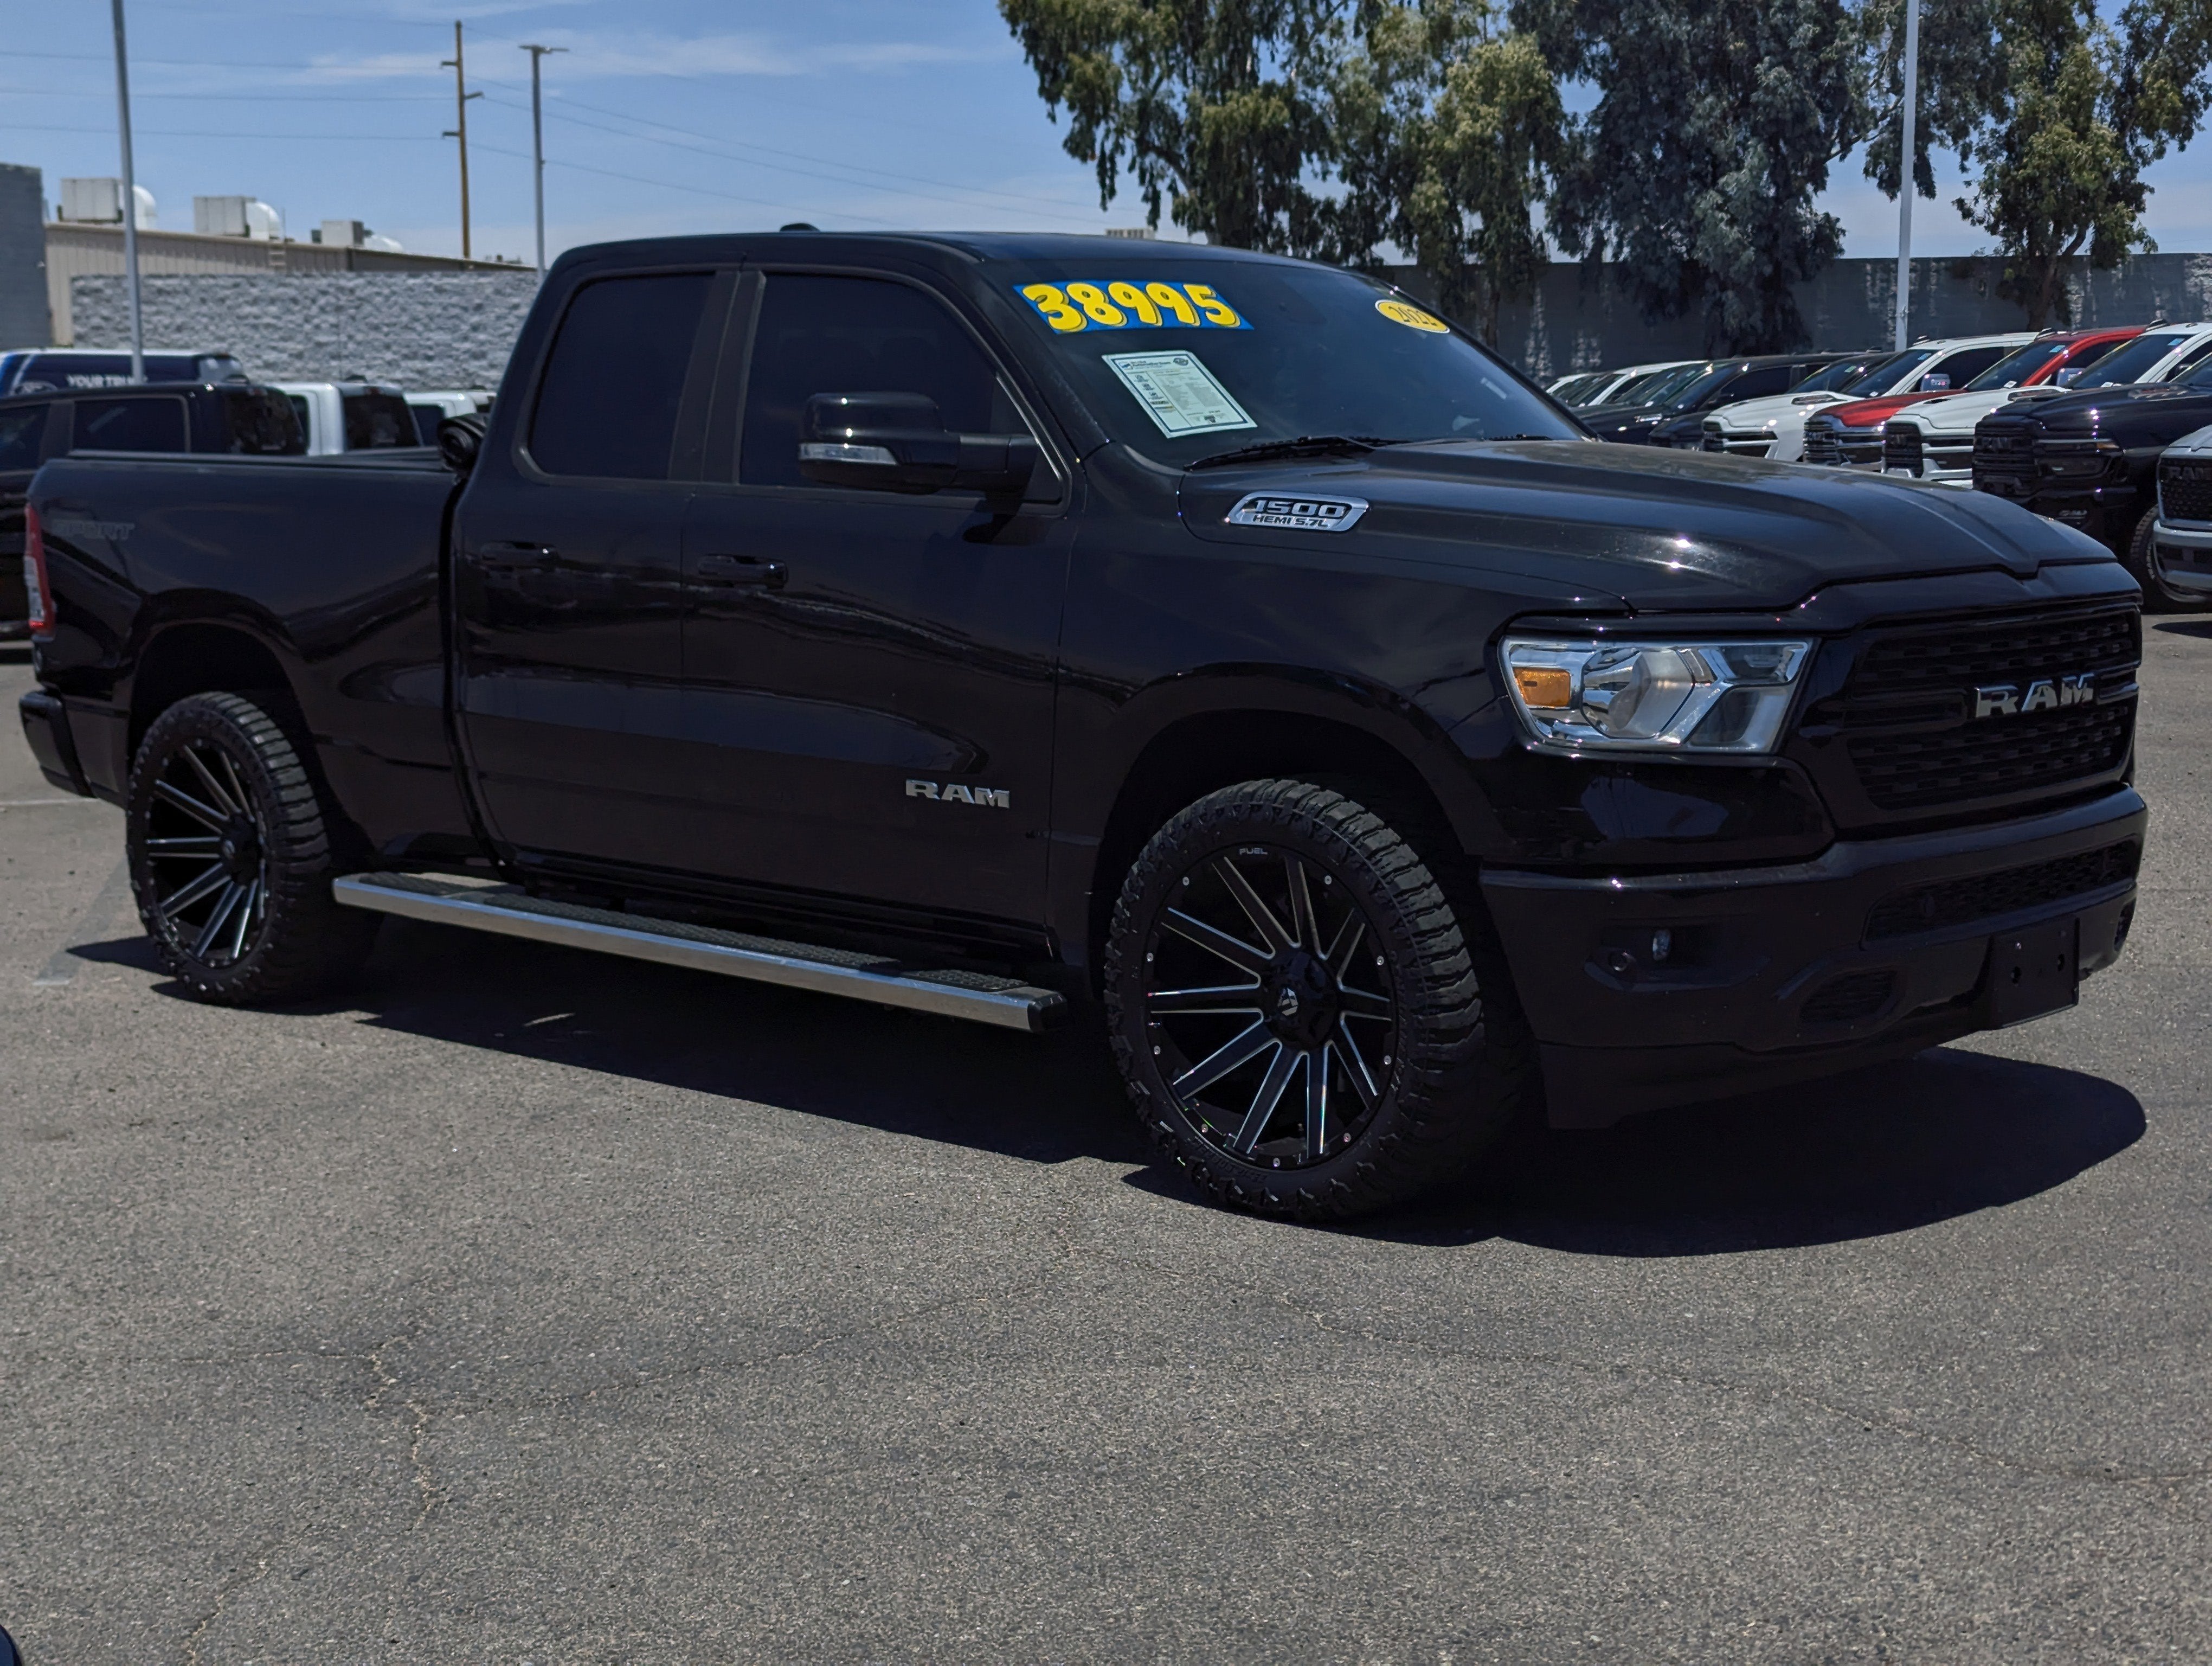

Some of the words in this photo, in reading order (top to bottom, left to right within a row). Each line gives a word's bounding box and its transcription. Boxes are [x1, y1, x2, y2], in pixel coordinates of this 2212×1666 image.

[1023, 282, 1240, 332] 38995
[66, 374, 104, 388] YOUR
[105, 374, 148, 387] TRU
[1255, 499, 1347, 518] 1500
[1252, 515, 1290, 524] HEMI
[1294, 517, 1329, 527] 5.7L
[1975, 673, 2094, 718] RAM
[905, 779, 1010, 809] RAM
[1239, 847, 1268, 856] FUEL
